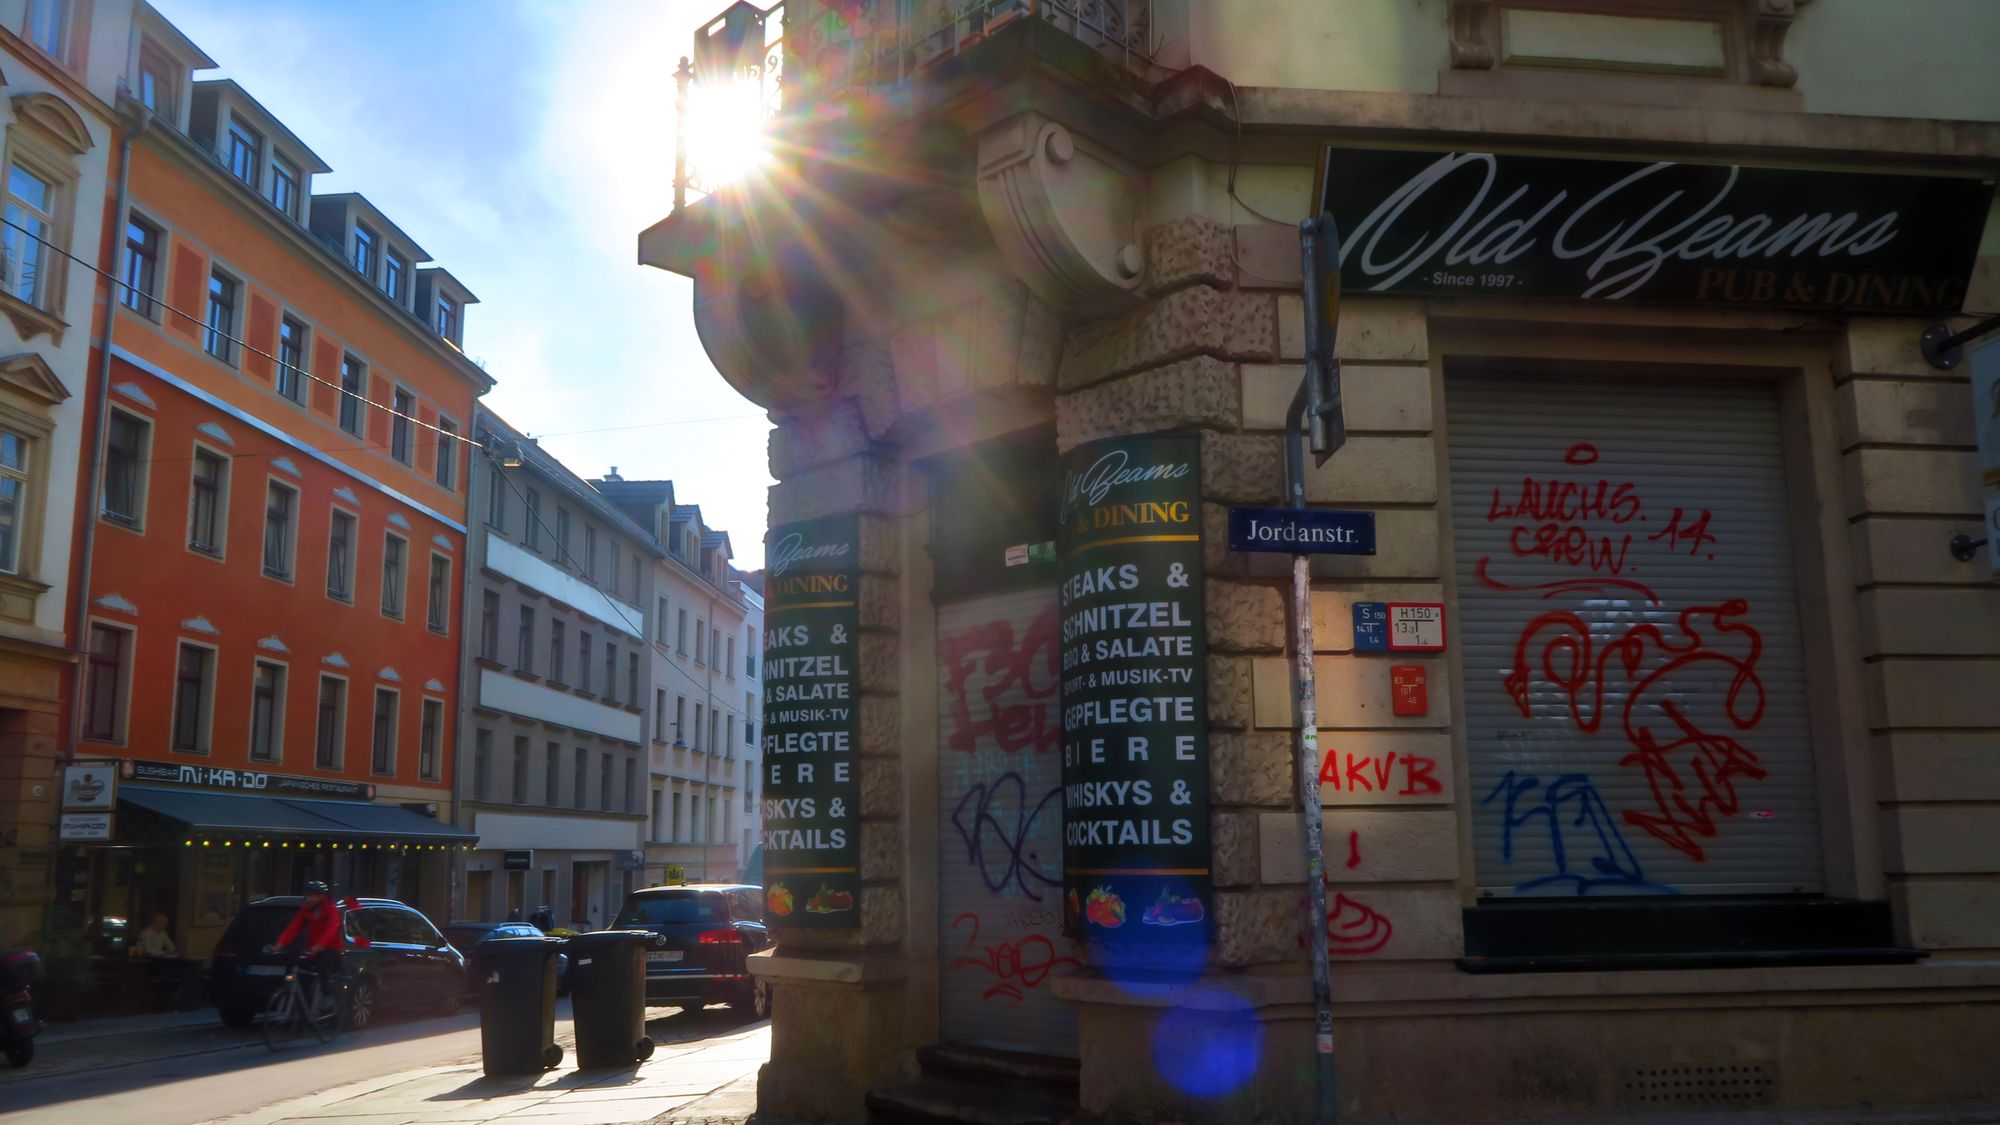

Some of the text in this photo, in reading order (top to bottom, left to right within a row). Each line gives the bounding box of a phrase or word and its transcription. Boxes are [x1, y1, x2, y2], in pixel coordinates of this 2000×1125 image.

[1339, 152, 1898, 299] Old Beams
[1432, 271, 1515, 288] Since 1997
[1697, 267, 1777, 303] PUB
[1784, 271, 1816, 303] &
[1081, 450, 1190, 506] Beams
[1093, 500, 1191, 530] DINING
[1247, 519, 1359, 544] Jordanstr.
[1063, 561, 1190, 607] STEAKS &
[1063, 602, 1192, 643] SCHNITZEL
[1362, 608, 1386, 620] S 150
[830, 623, 848, 645] &
[1081, 643, 1091, 664] &
[1095, 635, 1193, 661] SALATE
[775, 682, 849, 702] SALATE
[1088, 673, 1097, 689] &
[1101, 667, 1193, 687] MUSIK-TV
[779, 708, 849, 724] MUSIK-TV
[1065, 696, 1195, 731] GEPFLEGTE
[1318, 749, 1443, 796] AKVB
[829, 796, 846, 818] &
[1066, 779, 1192, 808] WHISKYS &
[1067, 818, 1193, 846] COCKTAILS
